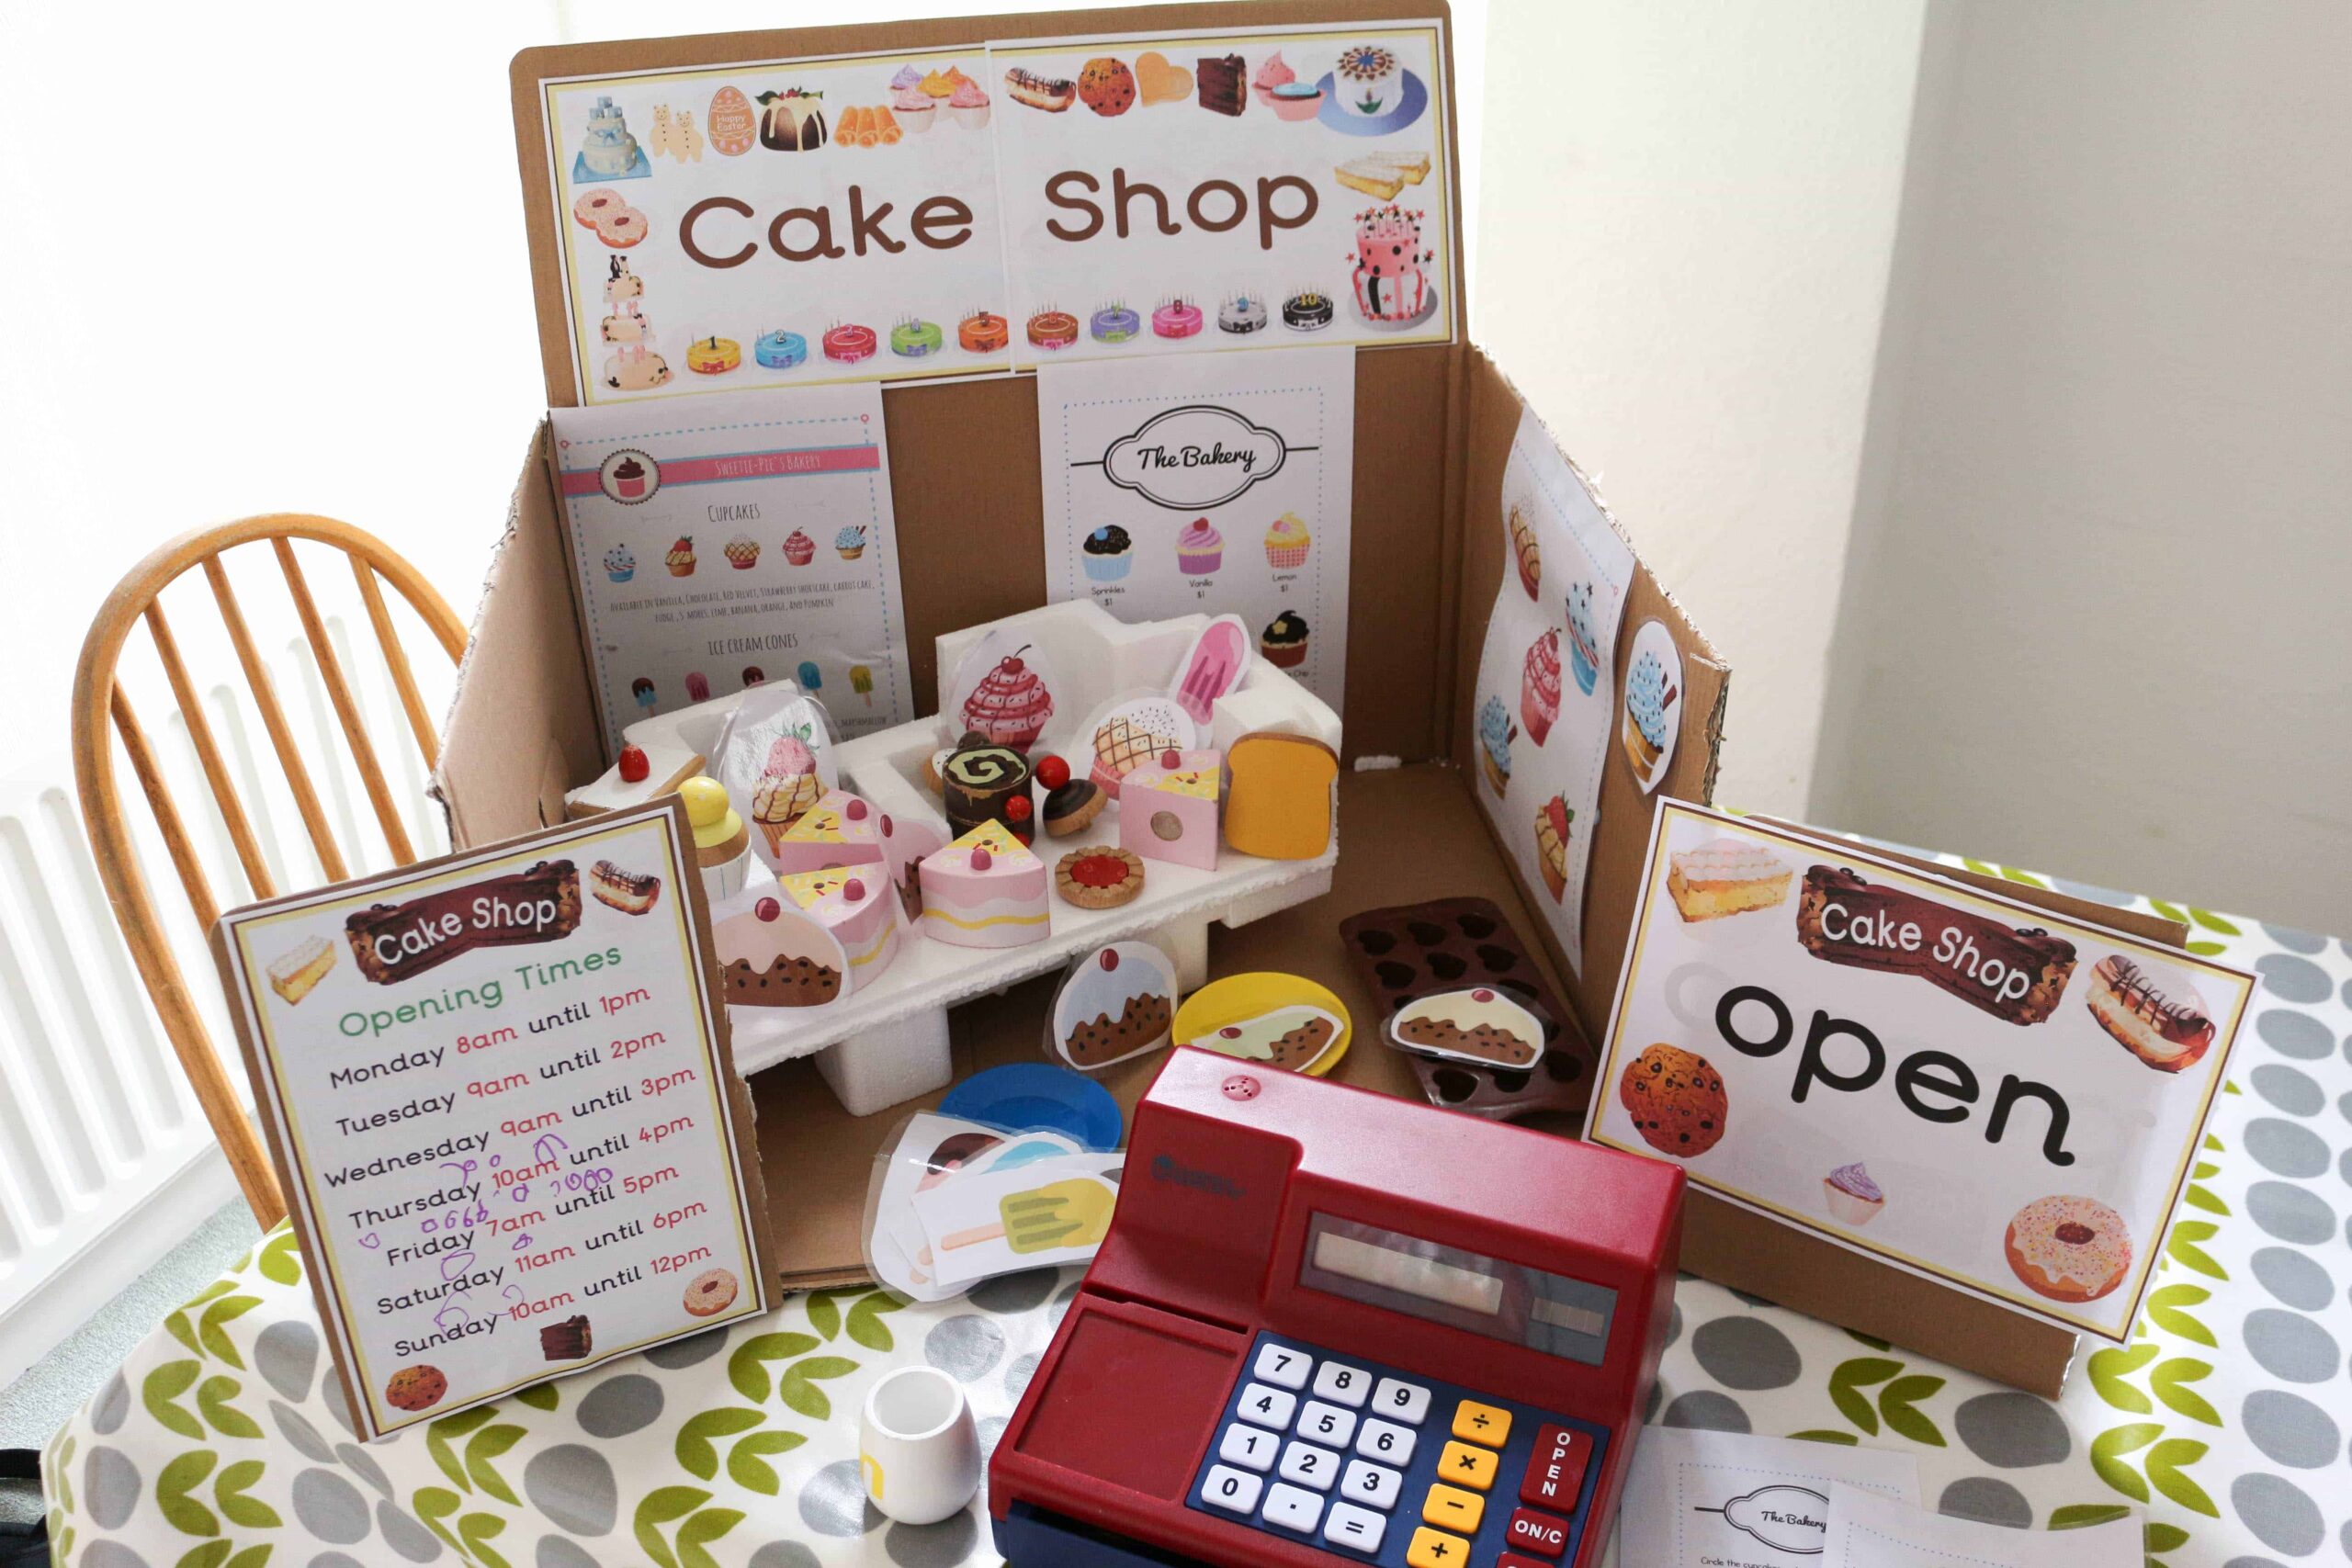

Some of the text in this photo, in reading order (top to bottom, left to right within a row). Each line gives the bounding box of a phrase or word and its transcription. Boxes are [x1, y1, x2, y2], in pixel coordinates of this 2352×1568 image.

[679, 165, 1319, 269] Cake Shop
[786, 455, 821, 470] BAKERY
[1137, 442, 1256, 473] The Bakery
[707, 502, 761, 523] CUPCAKES
[1189, 579, 1213, 588] Vanilla
[1272, 573, 1297, 582] Lemon
[1091, 586, 1125, 596] Sprinkles
[1197, 591, 1204, 599] $1
[1104, 598, 1113, 606] $1
[707, 633, 798, 657] ICE CREAM CONES
[374, 896, 557, 966] Cake Shop
[1820, 902, 2030, 1004] Cake Shop
[338, 946, 622, 1039] Opening Times
[329, 985, 651, 1089] Monday 8am until 1pm
[335, 1029, 666, 1137] Tuesday 9am until 2pm
[1715, 985, 2075, 1166] open
[324, 1067, 696, 1189] Wednesday 9am until 3pm
[348, 1181, 481, 1231] Thursday
[492, 1160, 560, 1190] 10am
[570, 1134, 629, 1166] until
[639, 1114, 695, 1145] 4pm
[387, 1231, 475, 1267] Friday
[485, 1208, 546, 1237] 7am
[555, 1185, 616, 1217] until
[623, 1165, 679, 1196] 5pm
[377, 1200, 708, 1315] Saturday 11am until 6pm
[394, 1245, 712, 1357] Sunday 10am until 12pm
[1273, 1355, 1292, 1372] 7
[1335, 1371, 1351, 1390] 8
[1255, 1395, 1272, 1414] 4
[1394, 1387, 1411, 1406] 9
[1317, 1415, 1336, 1434] 5
[1246, 1437, 1258, 1455] 1
[1376, 1432, 1395, 1451] 6
[1299, 1454, 1317, 1473] 2
[1541, 1432, 1571, 1497] OPEN
[1221, 1478, 1239, 1497] 0
[1363, 1472, 1379, 1492] 3
[1514, 1519, 1563, 1544] ON/C
[1761, 1510, 1827, 1533] The Bakery
[1701, 1556, 1724, 1566] Circle
[1727, 1559, 1741, 1568] the
